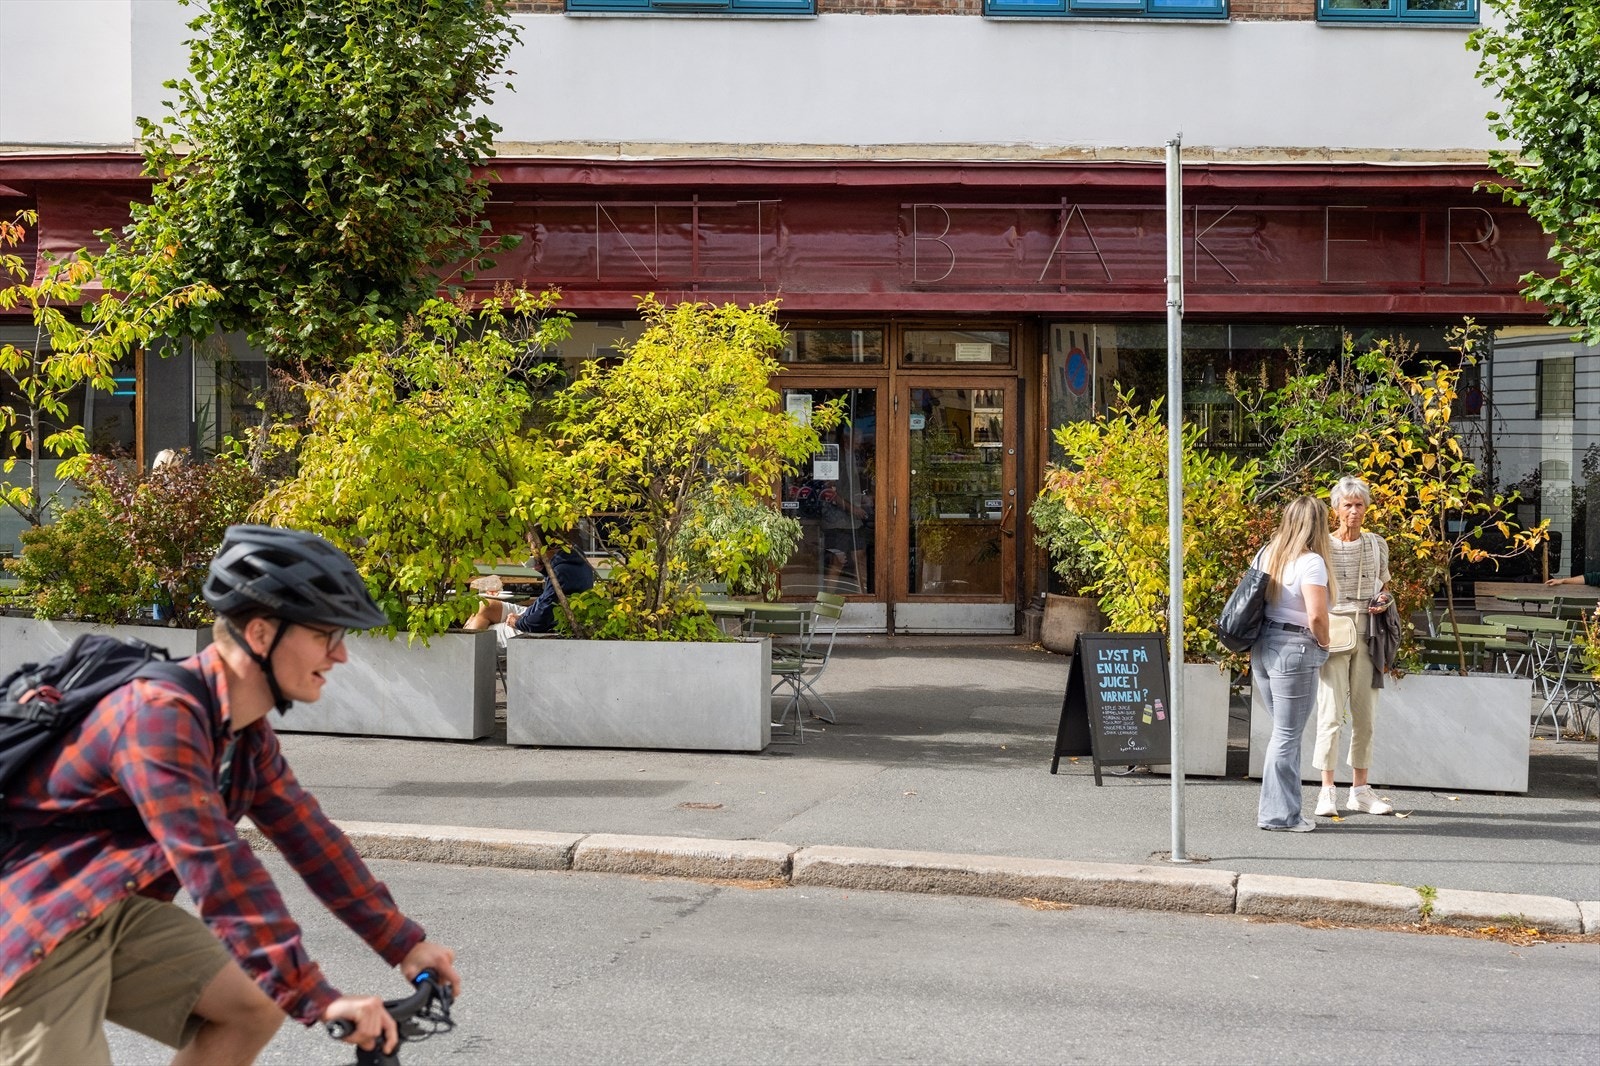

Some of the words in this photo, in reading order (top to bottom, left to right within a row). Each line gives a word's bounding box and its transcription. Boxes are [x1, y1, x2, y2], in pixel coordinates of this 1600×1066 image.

[470, 199, 783, 283] ENT
[911, 202, 1496, 286] BAKER
[1098, 649, 1129, 662] LYST
[1133, 646, 1148, 662] PÅ
[1097, 663, 1112, 674] EN
[1114, 663, 1139, 675] KALD
[1099, 676, 1131, 688] JUICE
[1134, 676, 1138, 689] I
